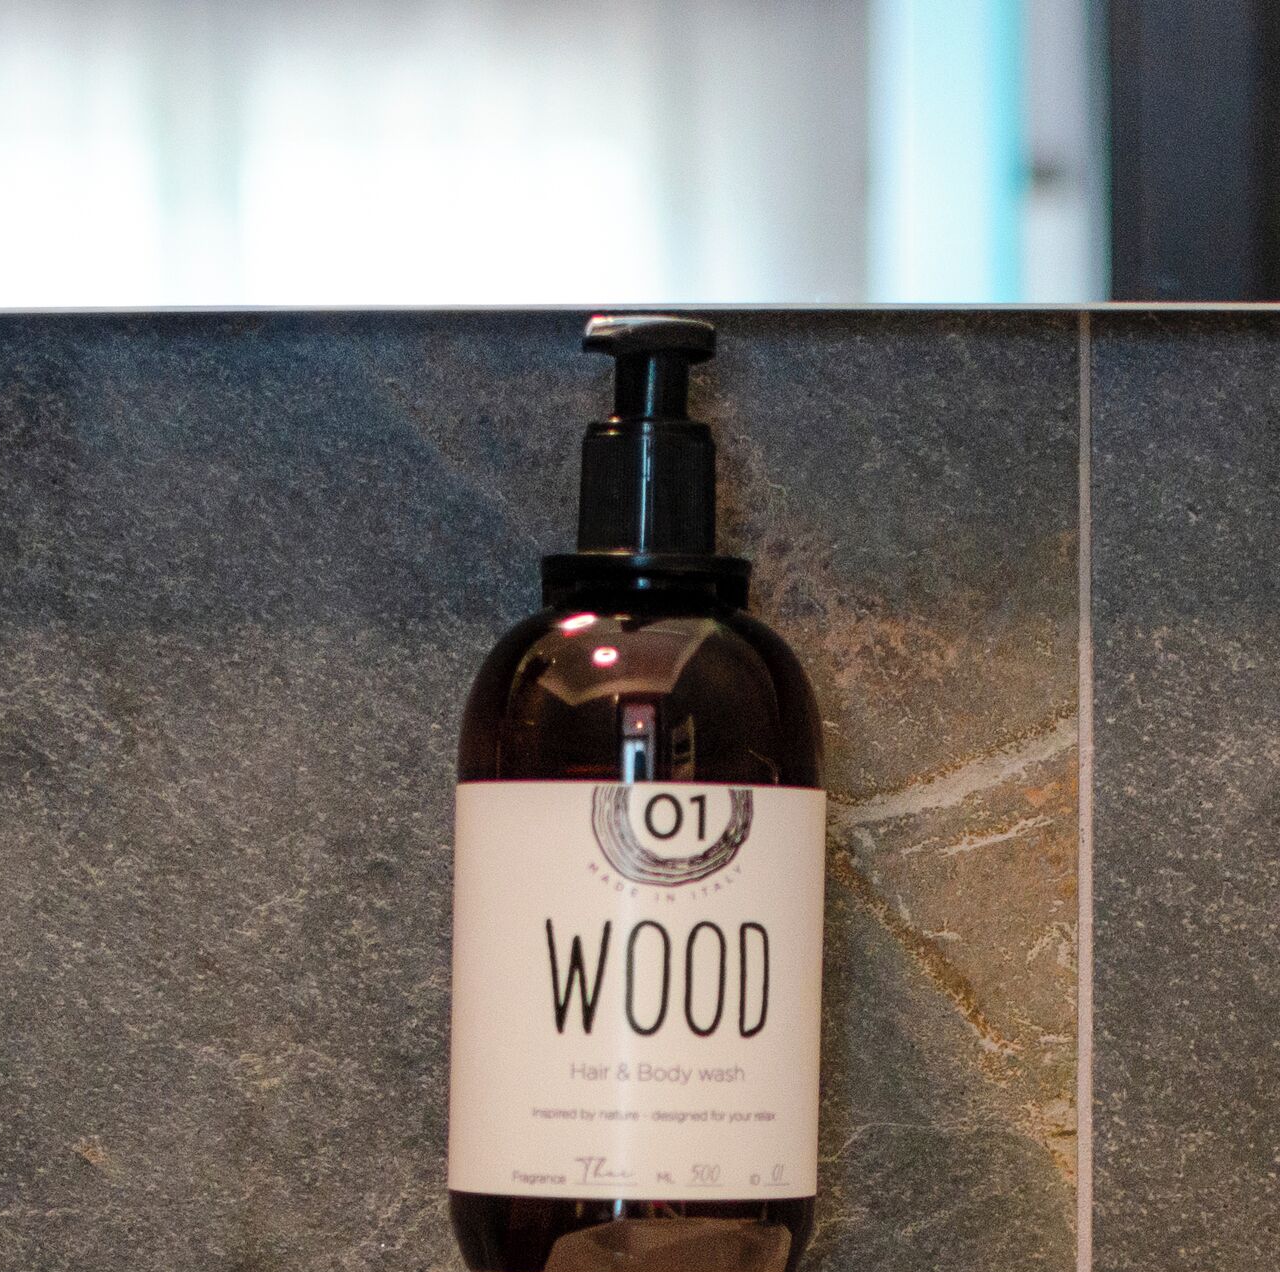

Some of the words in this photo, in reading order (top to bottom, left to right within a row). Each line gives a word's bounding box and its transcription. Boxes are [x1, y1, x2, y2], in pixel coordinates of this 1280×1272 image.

[644, 793, 706, 840] 01
[588, 863, 639, 897] MADE
[692, 864, 742, 899] ITALY
[545, 918, 770, 1038] WOOD
[570, 1063, 610, 1081] Hair
[616, 1063, 630, 1081] &
[637, 1063, 693, 1085] Body
[698, 1064, 746, 1082] wash
[531, 1108, 577, 1121] Inspired
[580, 1109, 596, 1122] by
[600, 1110, 639, 1121] nature
[651, 1110, 708, 1124] designed
[710, 1110, 725, 1122] for
[728, 1112, 751, 1124] your
[512, 1170, 567, 1185] Fragrance
